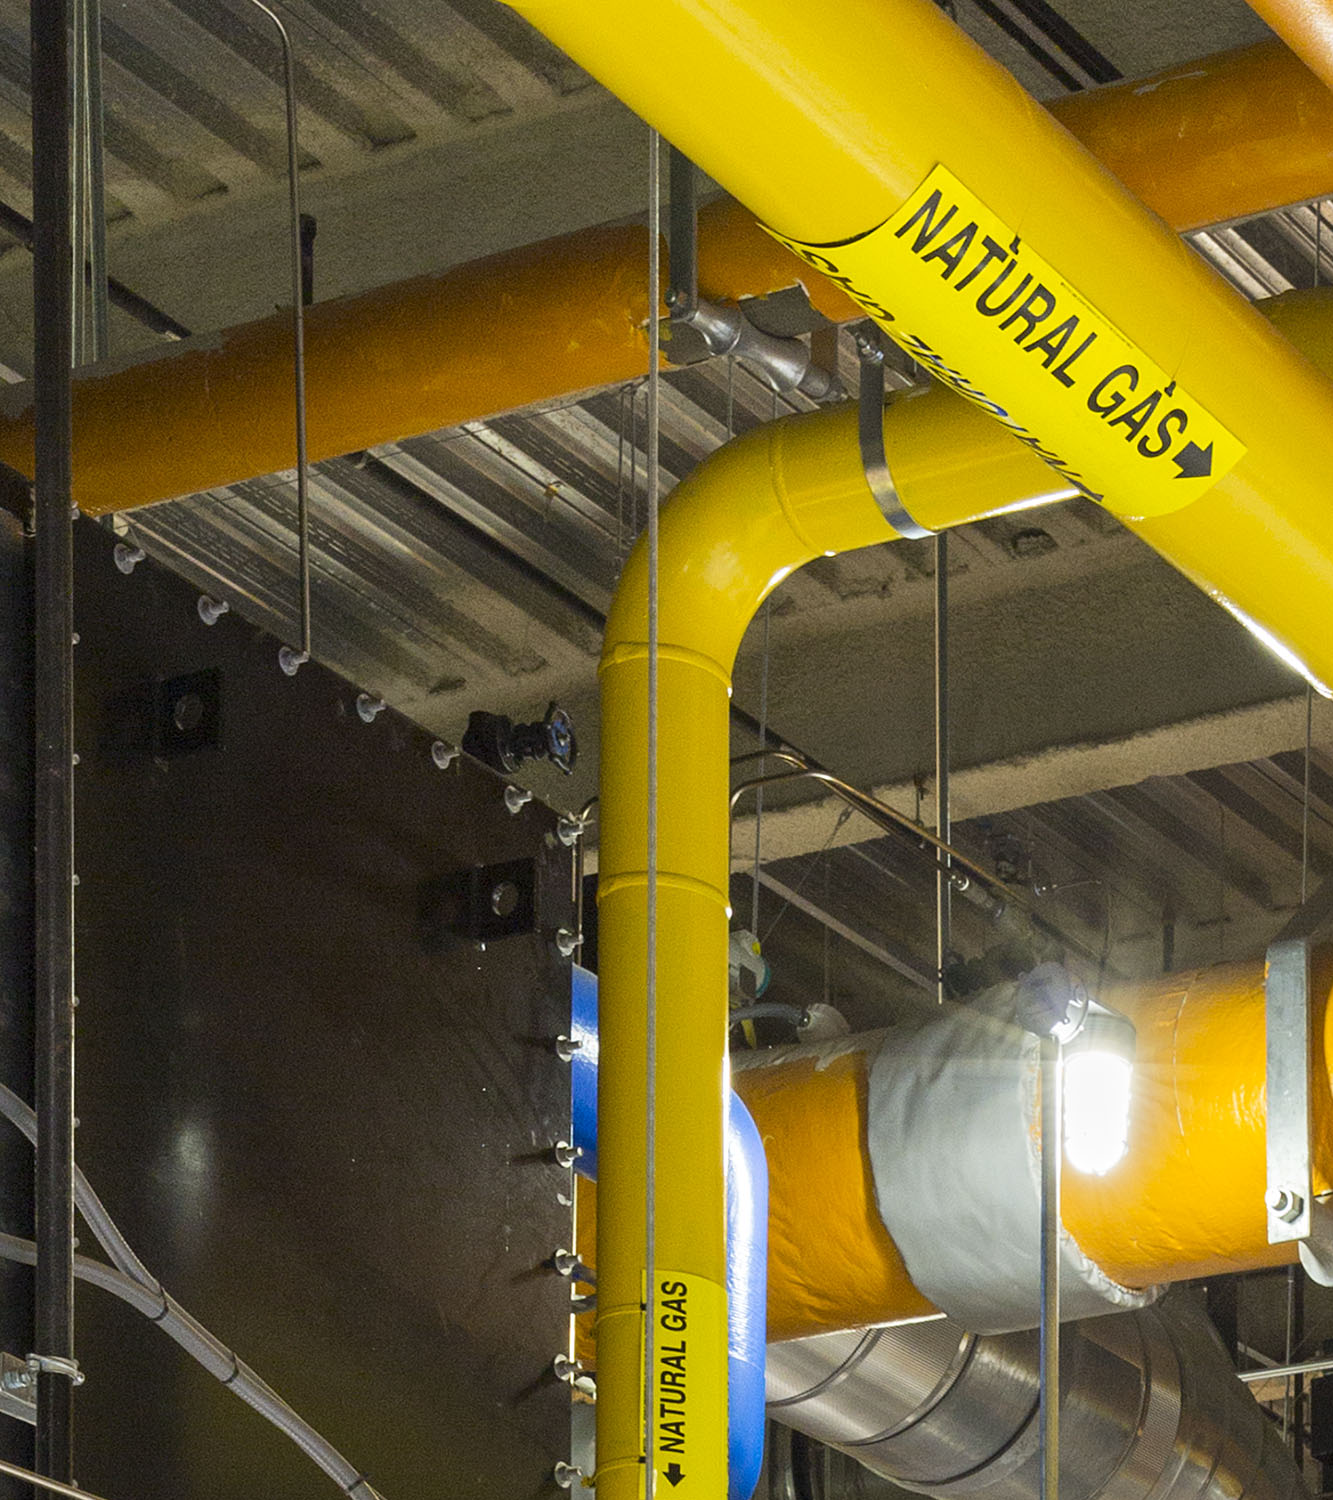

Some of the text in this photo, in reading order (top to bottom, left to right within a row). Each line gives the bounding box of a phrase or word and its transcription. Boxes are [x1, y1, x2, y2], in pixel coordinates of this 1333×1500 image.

[895, 189, 1188, 457] NATURAL GAS
[659, 1280, 690, 1455] NATURAL GAS
